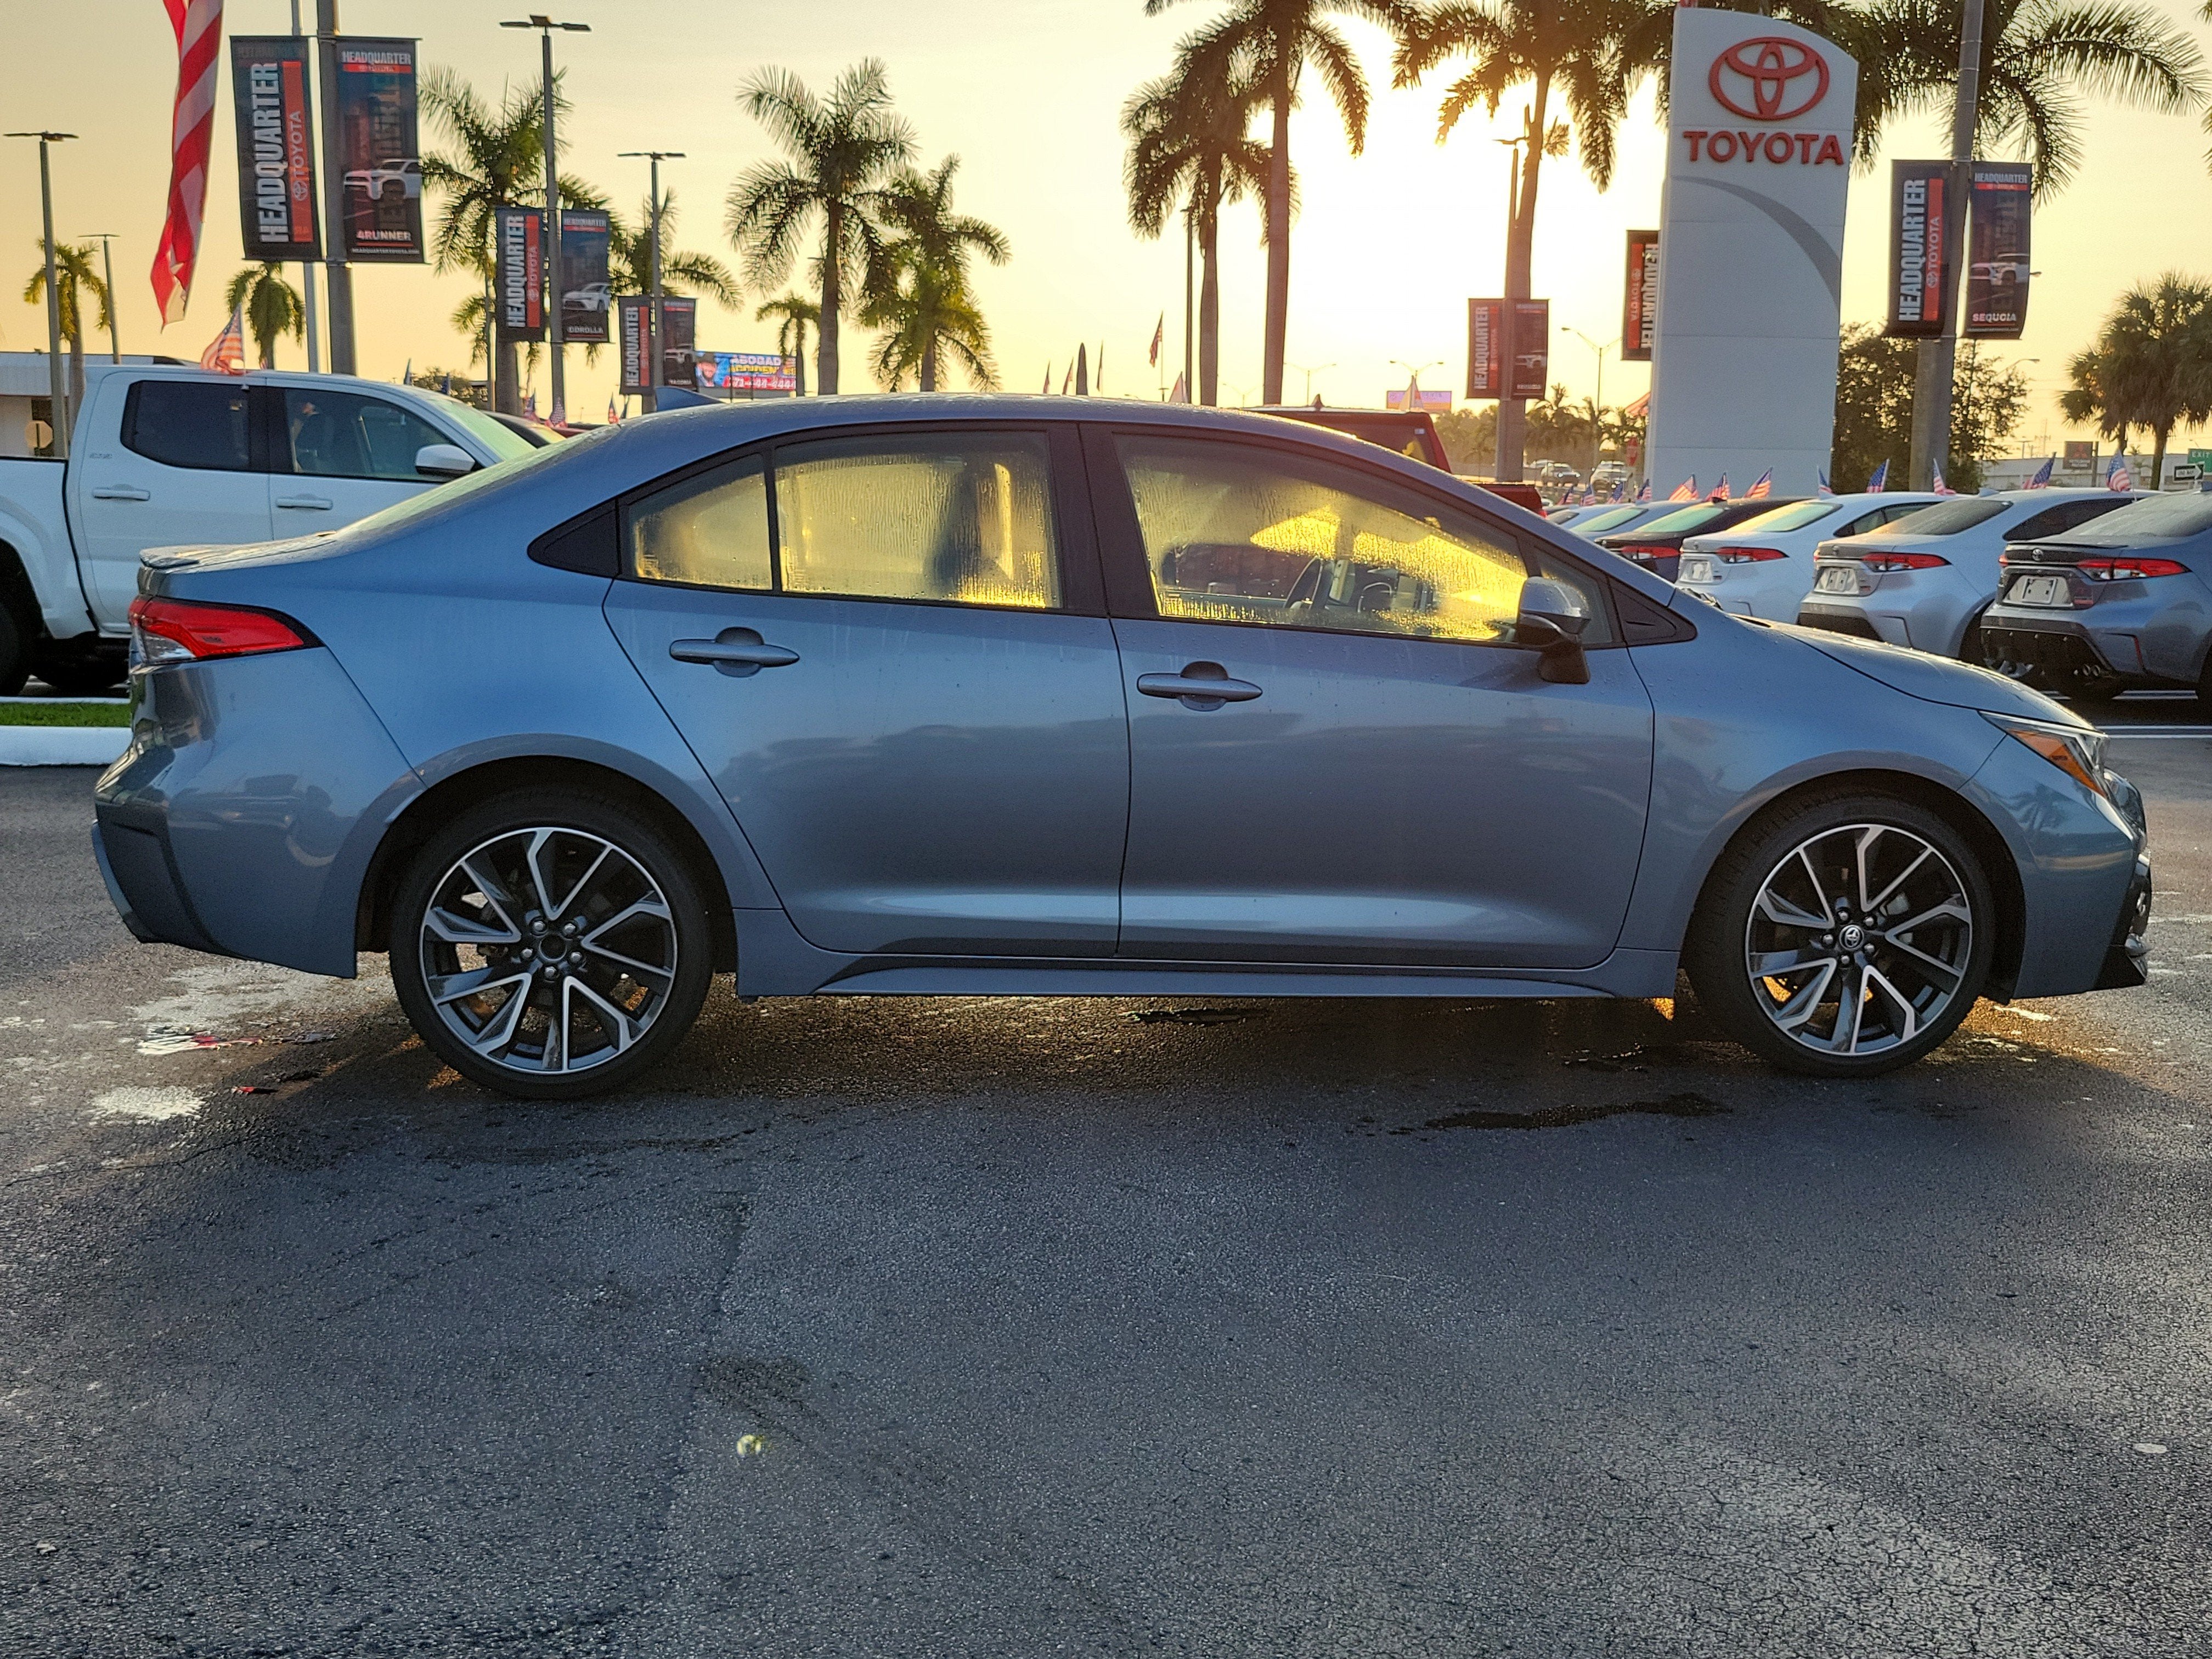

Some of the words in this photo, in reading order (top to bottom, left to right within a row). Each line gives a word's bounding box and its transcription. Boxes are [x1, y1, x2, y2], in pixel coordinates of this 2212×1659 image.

[342, 51, 411, 65] HEADQUARTER
[251, 62, 289, 243] HEADQUARTER
[289, 110, 309, 181] TOYOTA
[1682, 131, 1844, 165] TOYOTA
[1974, 173, 2028, 184] HEADQUARTER
[357, 230, 411, 241] 4RUNNER
[1898, 179, 1926, 322] HEADQUARTER
[1928, 217, 1940, 270] TOYOTA
[505, 216, 528, 328] HEADQUARTER
[527, 247, 538, 287] TOYOTA
[1972, 313, 2017, 323] SEQUOIA
[625, 307, 641, 387] HEADQUARTER
[1474, 307, 1489, 390] HEADQUARTER
